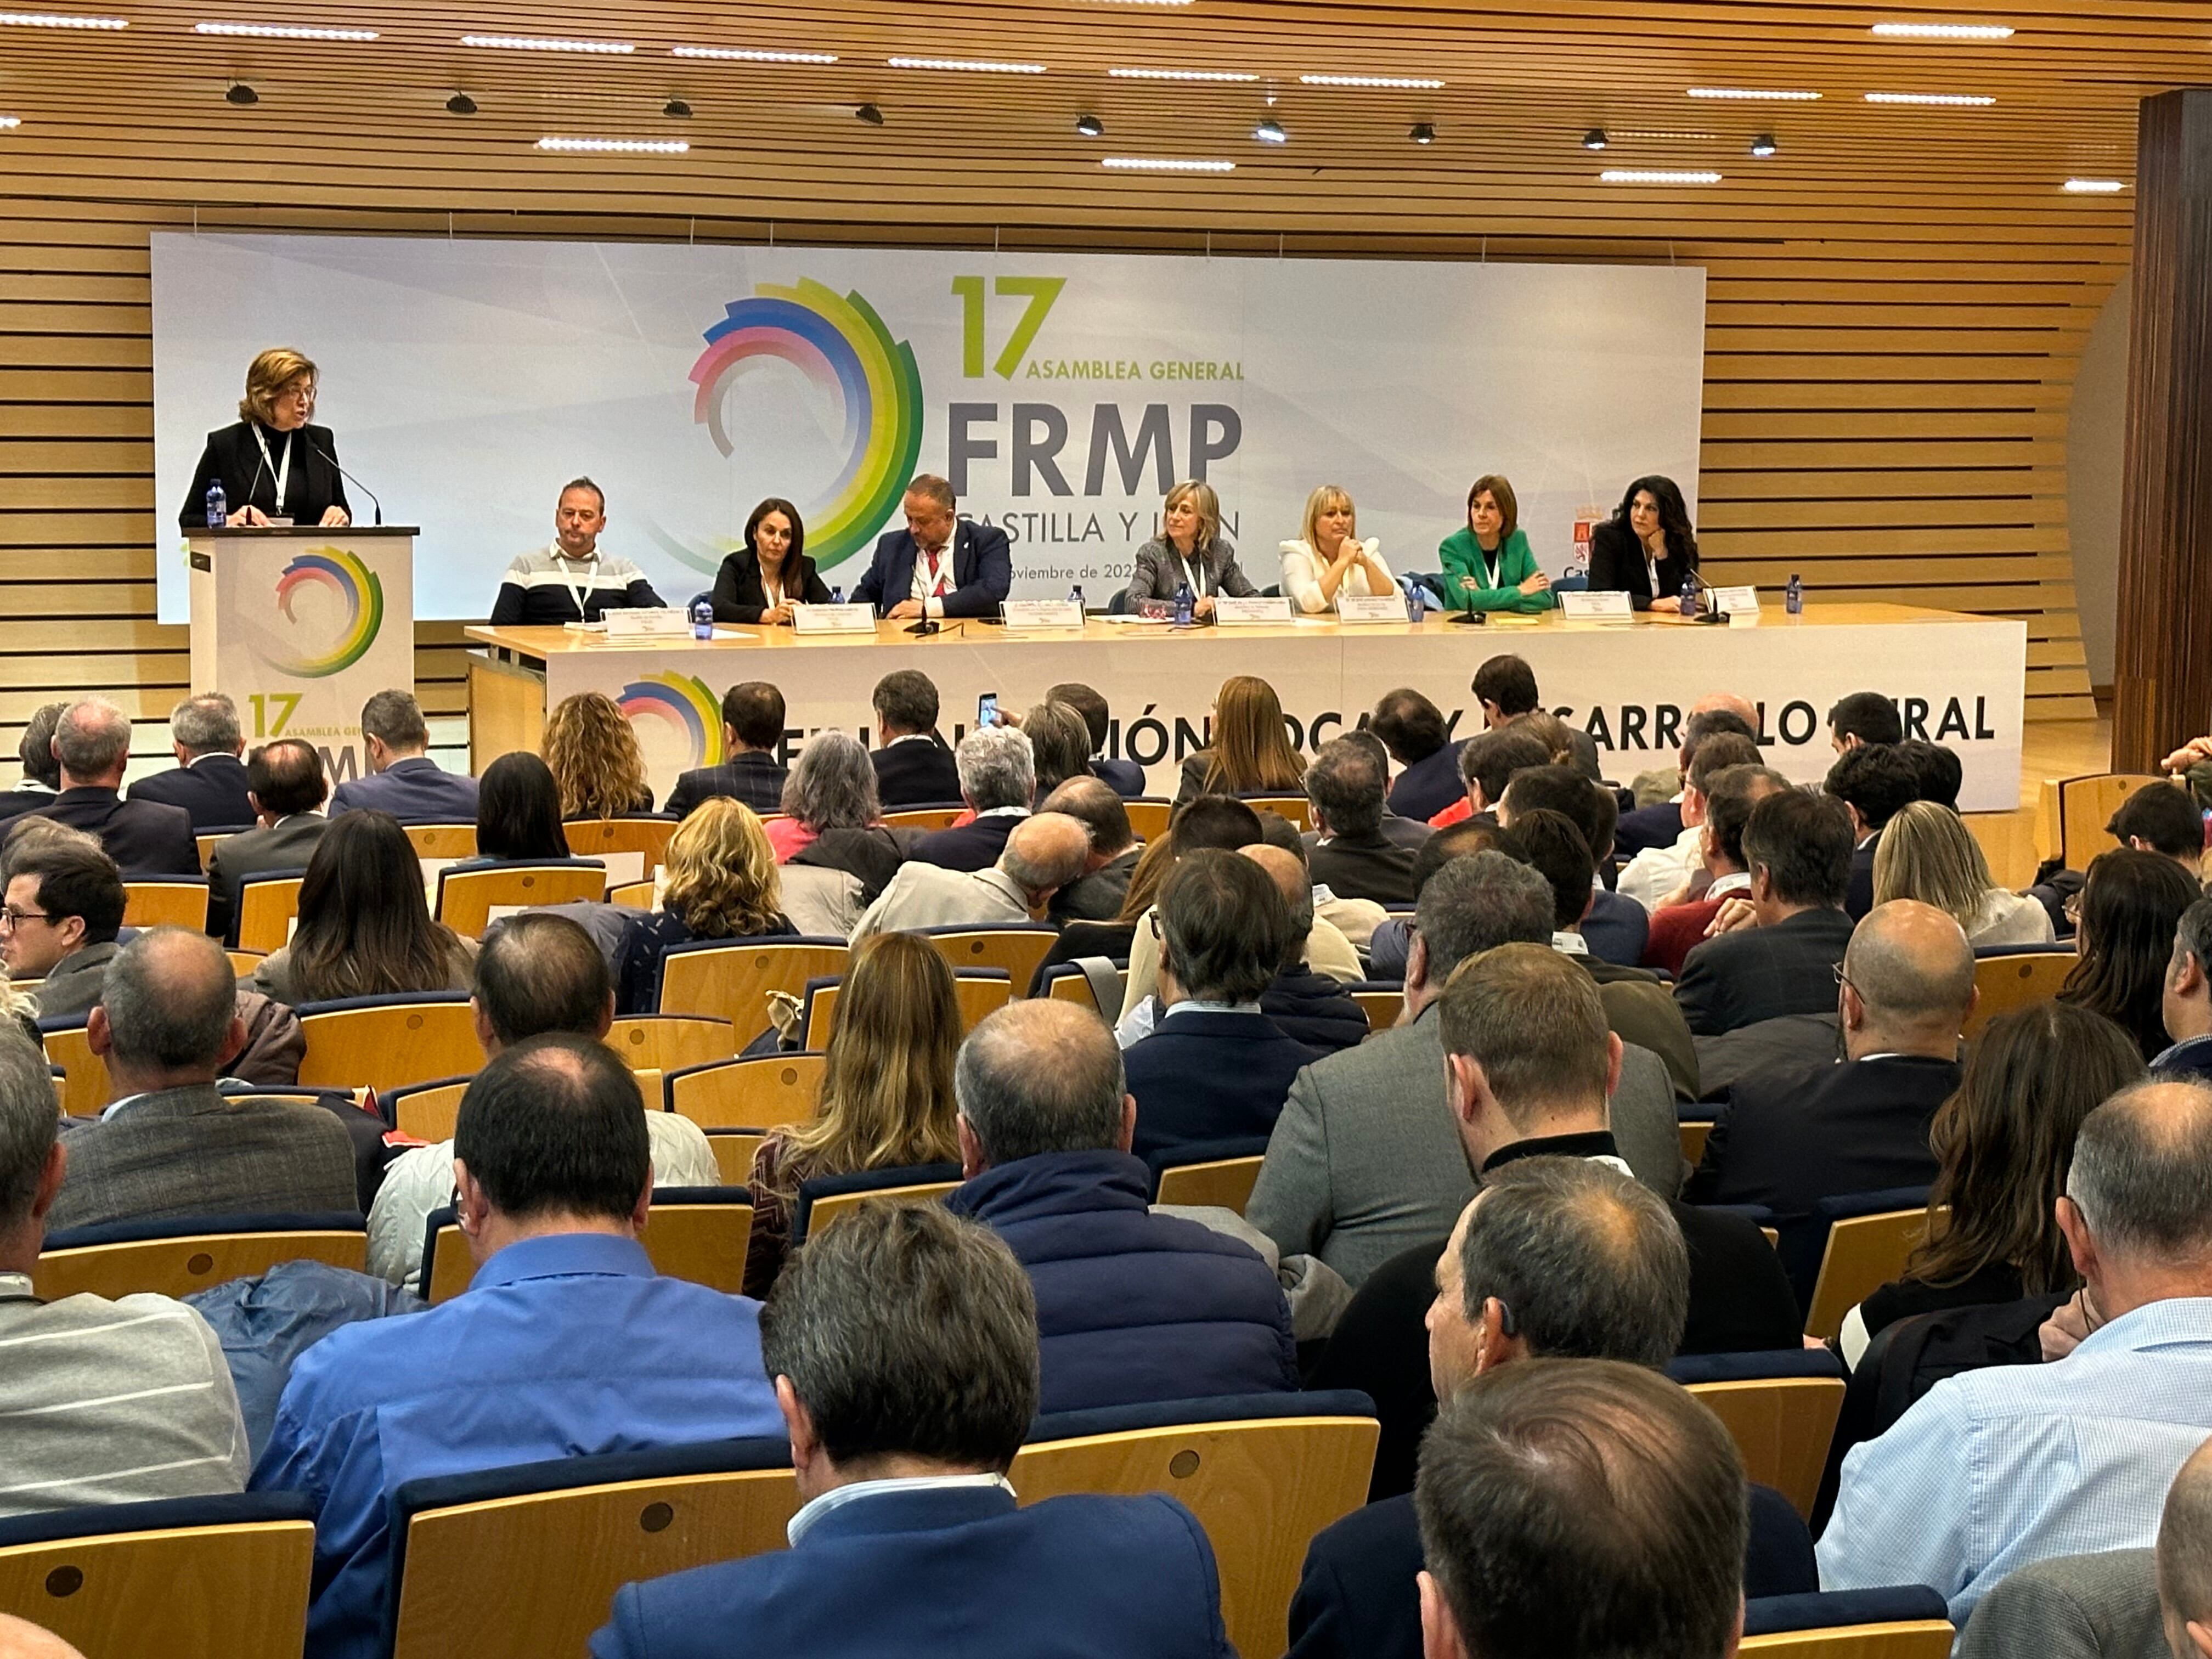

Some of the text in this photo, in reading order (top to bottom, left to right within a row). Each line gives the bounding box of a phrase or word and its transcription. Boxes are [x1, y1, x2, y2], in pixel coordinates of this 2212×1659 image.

[951, 276, 1068, 381] 17
[1026, 360, 1244, 381] ASAMBLEA GENERAL
[947, 403, 1242, 496] FRMP
[1119, 512, 1138, 541] Y
[1011, 563, 1137, 579] oviembre de 202
[249, 693, 303, 738] 17
[285, 726, 341, 737] ASAMBLEA
